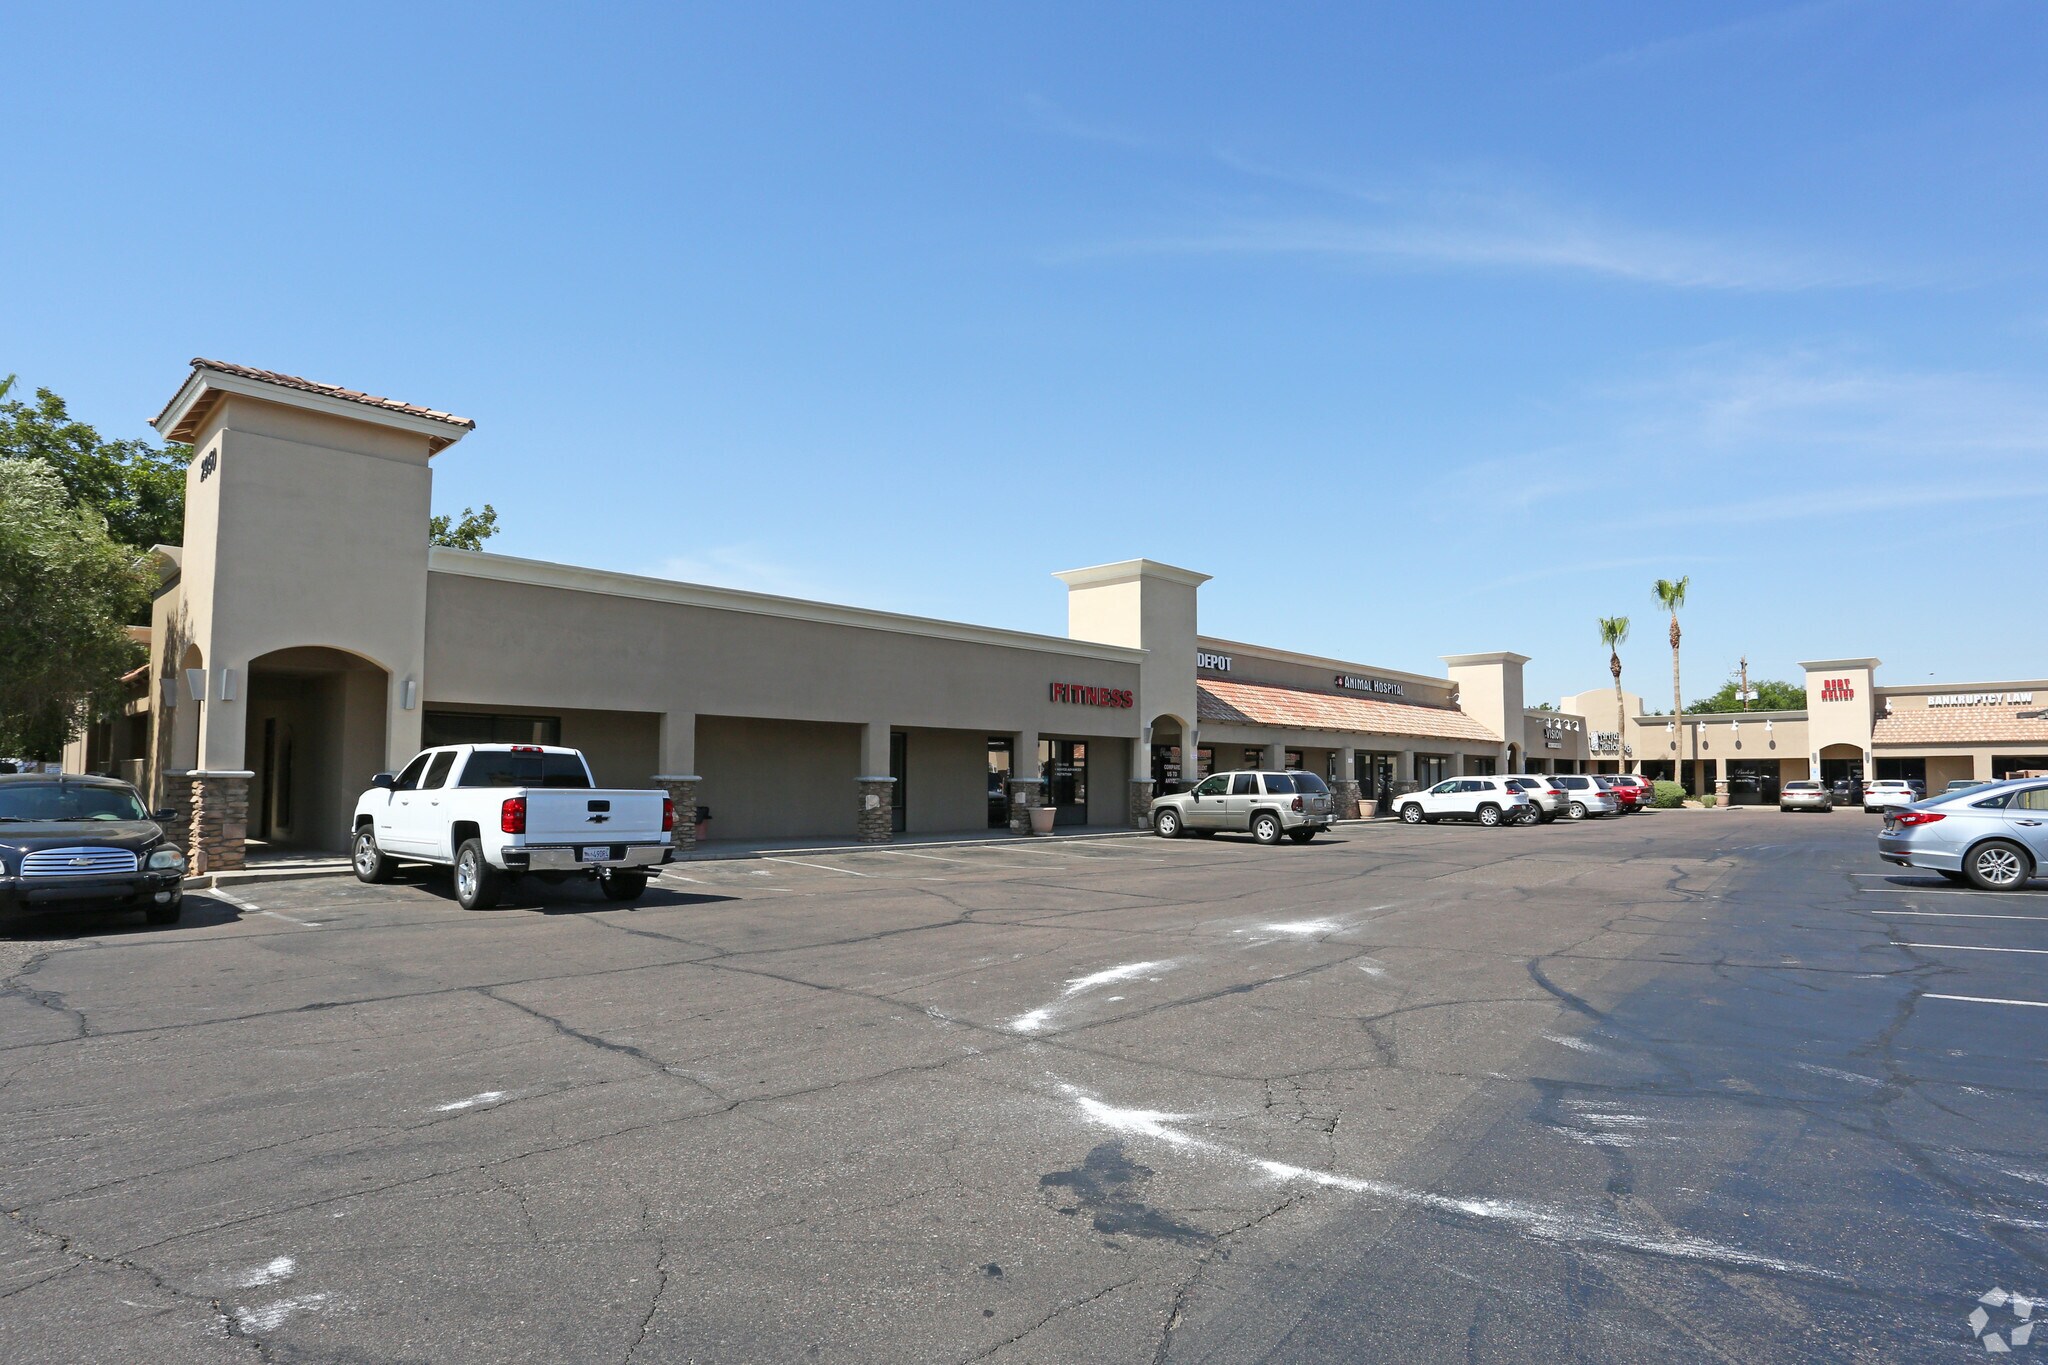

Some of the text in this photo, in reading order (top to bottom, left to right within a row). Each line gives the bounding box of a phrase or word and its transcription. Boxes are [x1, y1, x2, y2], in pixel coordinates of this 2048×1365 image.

[1197, 652, 1232, 671] DEPOT
[1052, 682, 1134, 708] FITNESS
[1927, 692, 2033, 706] BANKRUPTCY LAW
